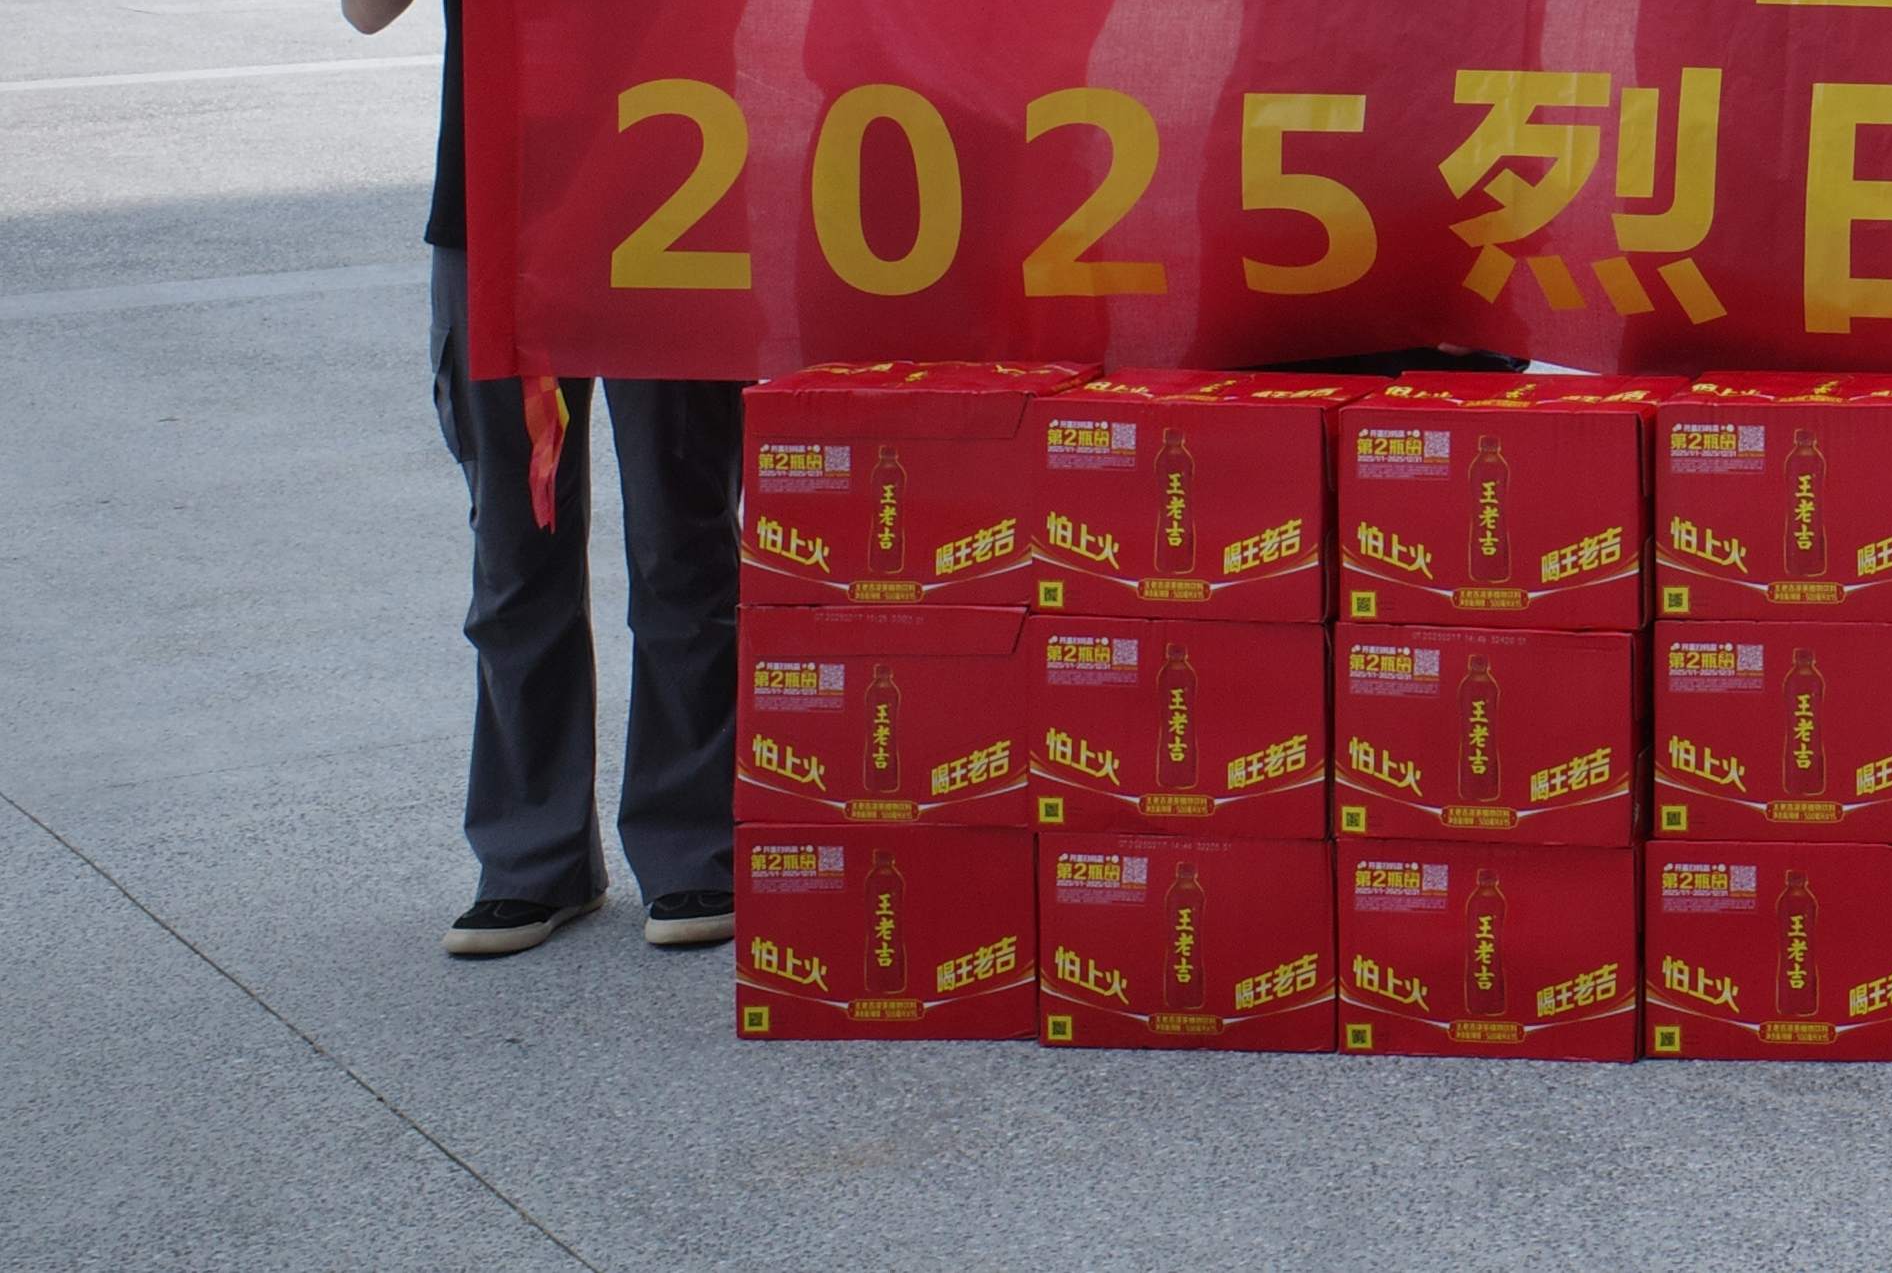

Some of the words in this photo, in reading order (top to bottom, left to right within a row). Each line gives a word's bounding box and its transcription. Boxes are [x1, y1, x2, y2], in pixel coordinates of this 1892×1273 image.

[878, 484, 897, 549] 王老吉
[1166, 473, 1185, 546] 王老吉
[1479, 481, 1499, 556] 王老吉
[1794, 474, 1815, 550] 王老吉
[757, 516, 830, 573] 怕上火
[935, 518, 1016, 575] 喝王老吉
[1046, 511, 1119, 570] 怕上火
[1223, 518, 1302, 575] 喝王老吉
[1357, 521, 1433, 580] 怕上火
[1541, 526, 1622, 583] 喝王老吉
[1670, 516, 1748, 573] 怕上火
[873, 704, 890, 769] 王老吉
[1168, 688, 1188, 762] 王老吉
[1468, 700, 1489, 774] 王老吉
[1793, 694, 1814, 769] 王老吉
[752, 734, 826, 791] 怕上火
[931, 740, 1010, 795] 喝王老吉
[1046, 728, 1120, 786] 怕上火
[1227, 734, 1308, 789] 喝王老吉
[1349, 736, 1422, 796] 怕上火
[1530, 748, 1611, 802] 喝王老吉
[1668, 735, 1746, 792] 怕上火
[875, 893, 894, 966] 王老吉
[1174, 908, 1194, 983] 王老吉
[1475, 916, 1494, 990] 王老吉
[1787, 915, 1807, 989] 王老吉
[751, 937, 828, 991] 怕上火
[937, 937, 1016, 992] 喝王老吉
[1055, 946, 1128, 1003] 怕上火
[1235, 954, 1318, 1009] 喝王老吉
[1353, 955, 1428, 1010] 怕上火
[1537, 963, 1618, 1017] 喝王老吉
[1662, 956, 1739, 1013] 怕上火
